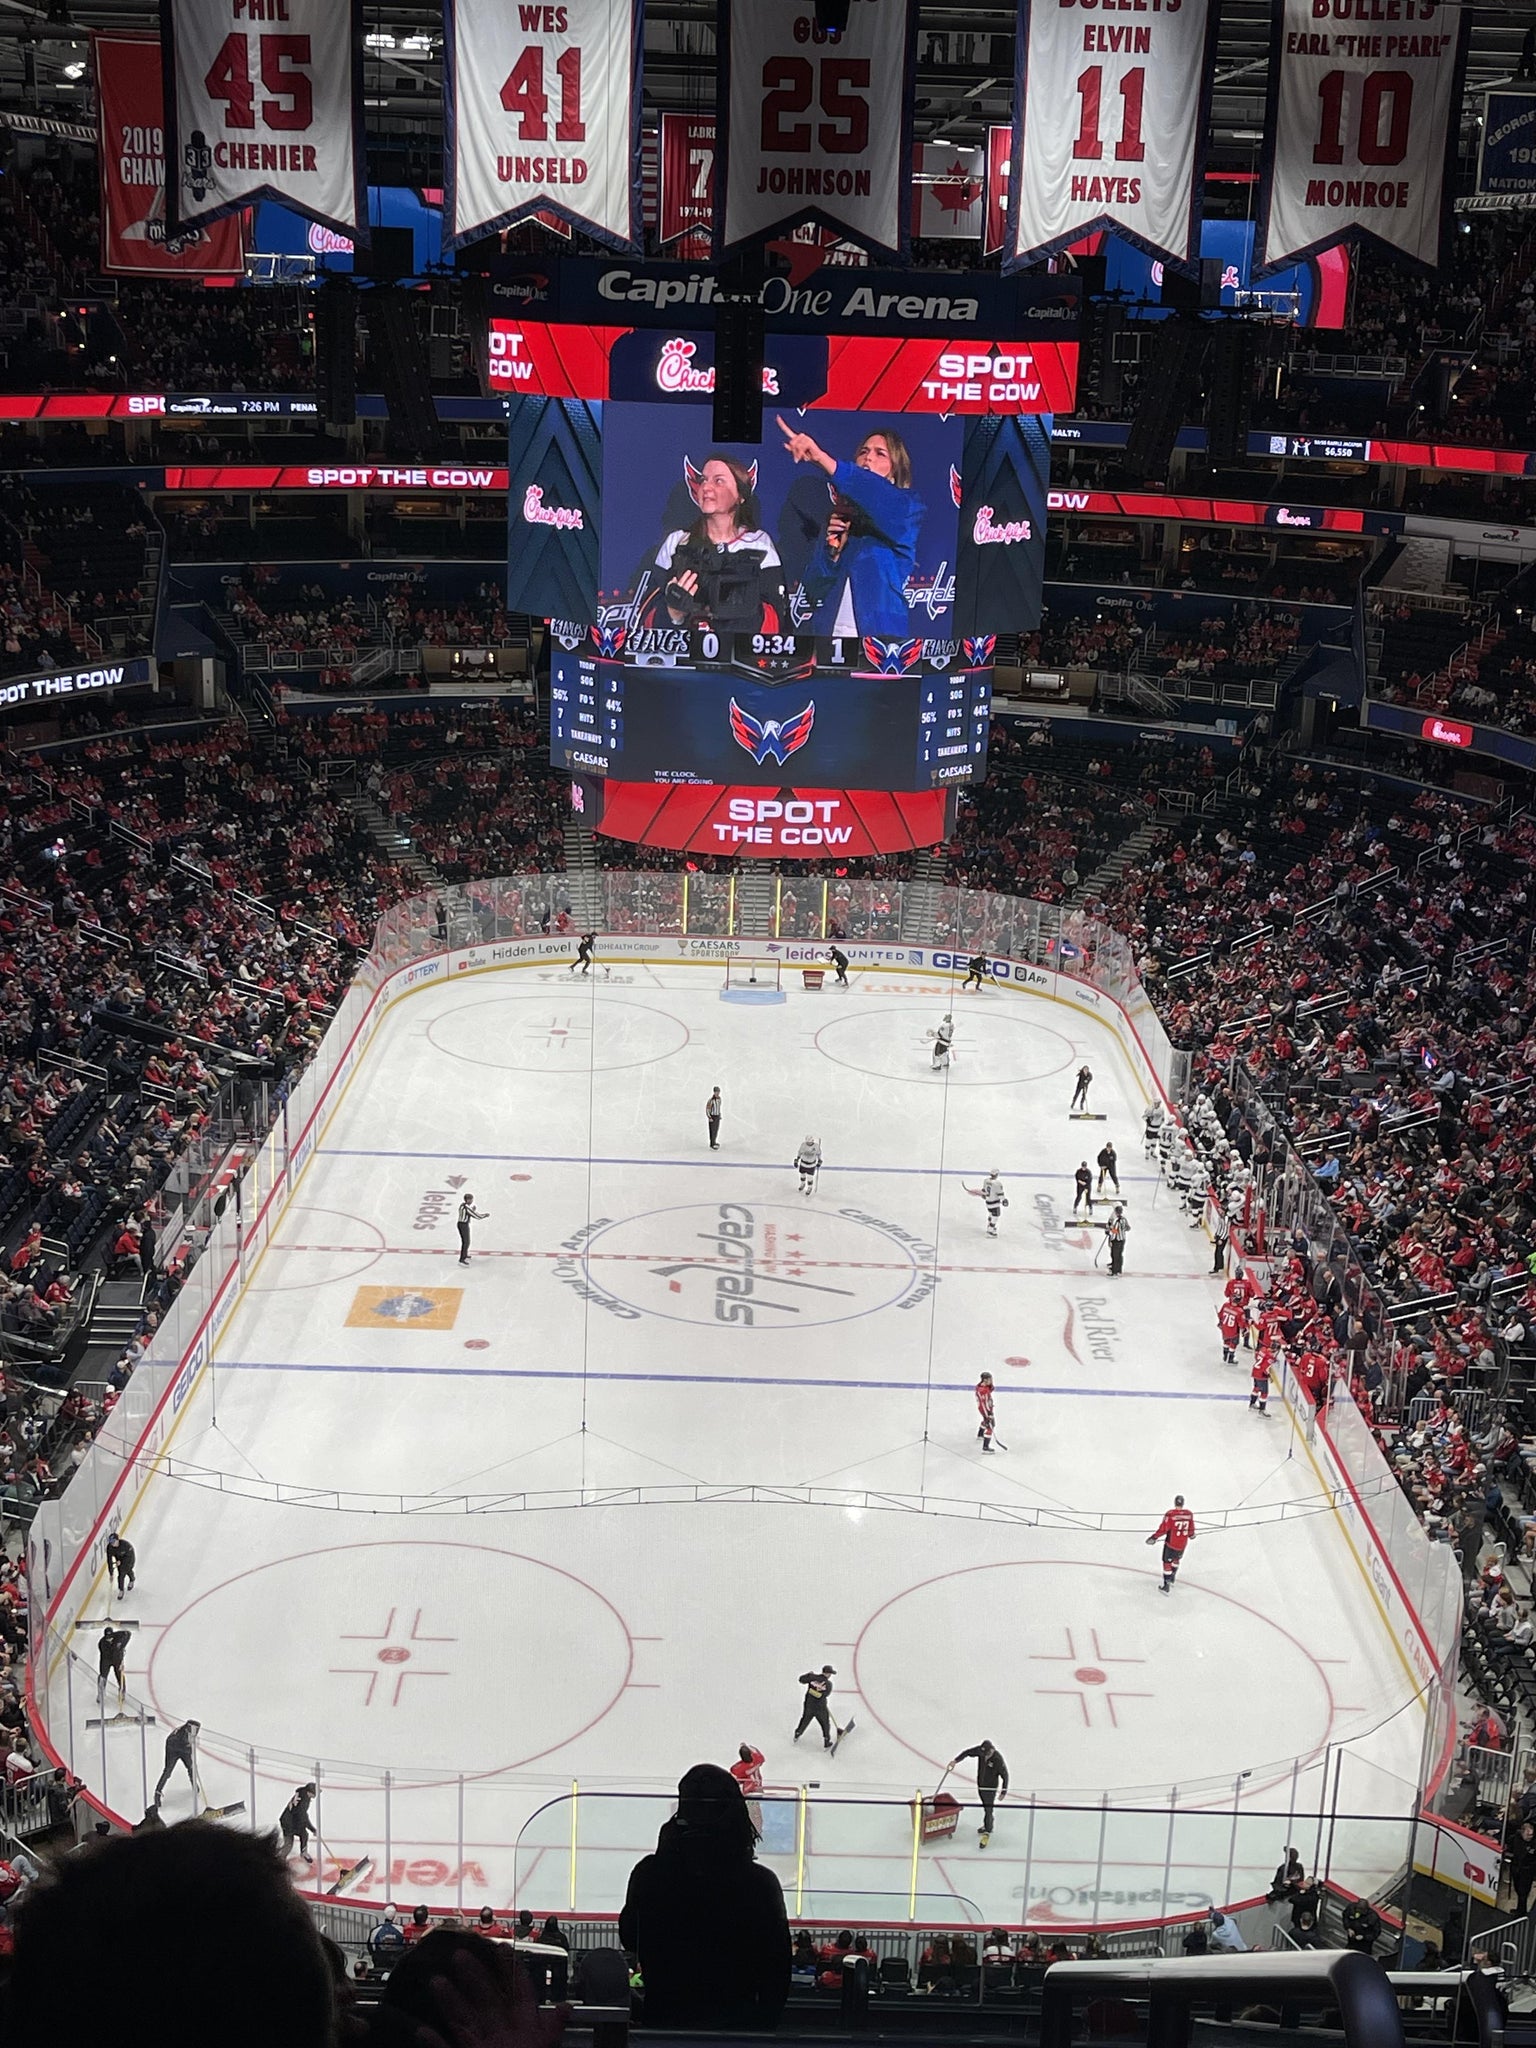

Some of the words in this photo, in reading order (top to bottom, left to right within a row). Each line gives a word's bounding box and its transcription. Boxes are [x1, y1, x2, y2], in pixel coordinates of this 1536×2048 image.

[233, 0, 289, 21] PHIL
[519, 4, 569, 34] WES
[1311, 0, 1434, 21] BULLETS
[1082, 25, 1151, 54] ELVIN
[1286, 33, 1330, 56] EARL
[204, 32, 313, 131] 45
[499, 45, 587, 142] 41
[760, 55, 871, 154] 25
[1072, 65, 1146, 163] 11
[1312, 69, 1414, 167] 10
[121, 126, 164, 155] 2019
[213, 141, 318, 172] CHENIER
[497, 155, 588, 184] UNSELD
[690, 148, 715, 199] 7
[757, 167, 872, 197] JOHNSON
[1070, 175, 1142, 205] HAYES
[1304, 179, 1409, 208] MONROE
[841, 287, 980, 322] Arena
[489, 332, 524, 357] OT
[938, 354, 1034, 381] SPOT
[921, 381, 982, 401] THE
[988, 383, 1041, 402] COW
[241, 401, 263, 413] 7:26
[263, 401, 281, 413] PM
[1324, 447, 1353, 458] $6,550
[307, 468, 373, 485] SPOT
[377, 469, 428, 486] THE
[432, 470, 494, 487] COW
[1047, 492, 1090, 509] OW
[625, 627, 692, 655] KINGS
[702, 633, 720, 659] 0
[752, 633, 796, 656] 9:34
[831, 638, 846, 664] 1
[32, 675, 74, 697] THE
[76, 667, 125, 691] COW
[557, 669, 564, 682] 4
[580, 675, 594, 687] SOG
[610, 680, 618, 693] 3
[552, 687, 569, 702] 56%
[605, 698, 623, 713] 44%
[926, 692, 933, 704] 4
[949, 689, 964, 701] SOG
[979, 686, 986, 698] 3
[557, 707, 564, 719] 7
[610, 719, 617, 730] 5
[921, 711, 938, 724] 56%
[973, 704, 989, 717] 44%
[557, 726, 563, 738] 1
[610, 737, 616, 749] 0
[925, 730, 932, 742] 7
[976, 723, 983, 735] 5
[573, 751, 609, 769] CAESARS
[924, 749, 930, 761] 1
[975, 741, 982, 753] 0
[687, 778, 714, 786] GOING
[938, 764, 973, 779] CAESARS
[728, 798, 840, 824] SPOT
[713, 823, 773, 844] THE
[780, 826, 853, 845] COW
[492, 945, 536, 960] Hidden
[538, 942, 572, 954] Level
[690, 939, 741, 951] CAESARS
[786, 946, 833, 961] leidos
[847, 950, 905, 961] UNITED
[404, 962, 440, 984] LOTTERY
[1161, 1131, 1172, 1143] 44
[412, 1190, 457, 1231] leidos
[560, 1217, 614, 1251] Arena
[897, 1272, 943, 1311] Arena
[1075, 1296, 1115, 1323] Red
[1221, 1312, 1236, 1328] 76
[1084, 1325, 1122, 1363] River
[1254, 1355, 1263, 1369] 2
[1306, 1364, 1314, 1378] 3
[173, 1340, 203, 1414] GEICO
[286, 1855, 490, 1893] verizo
